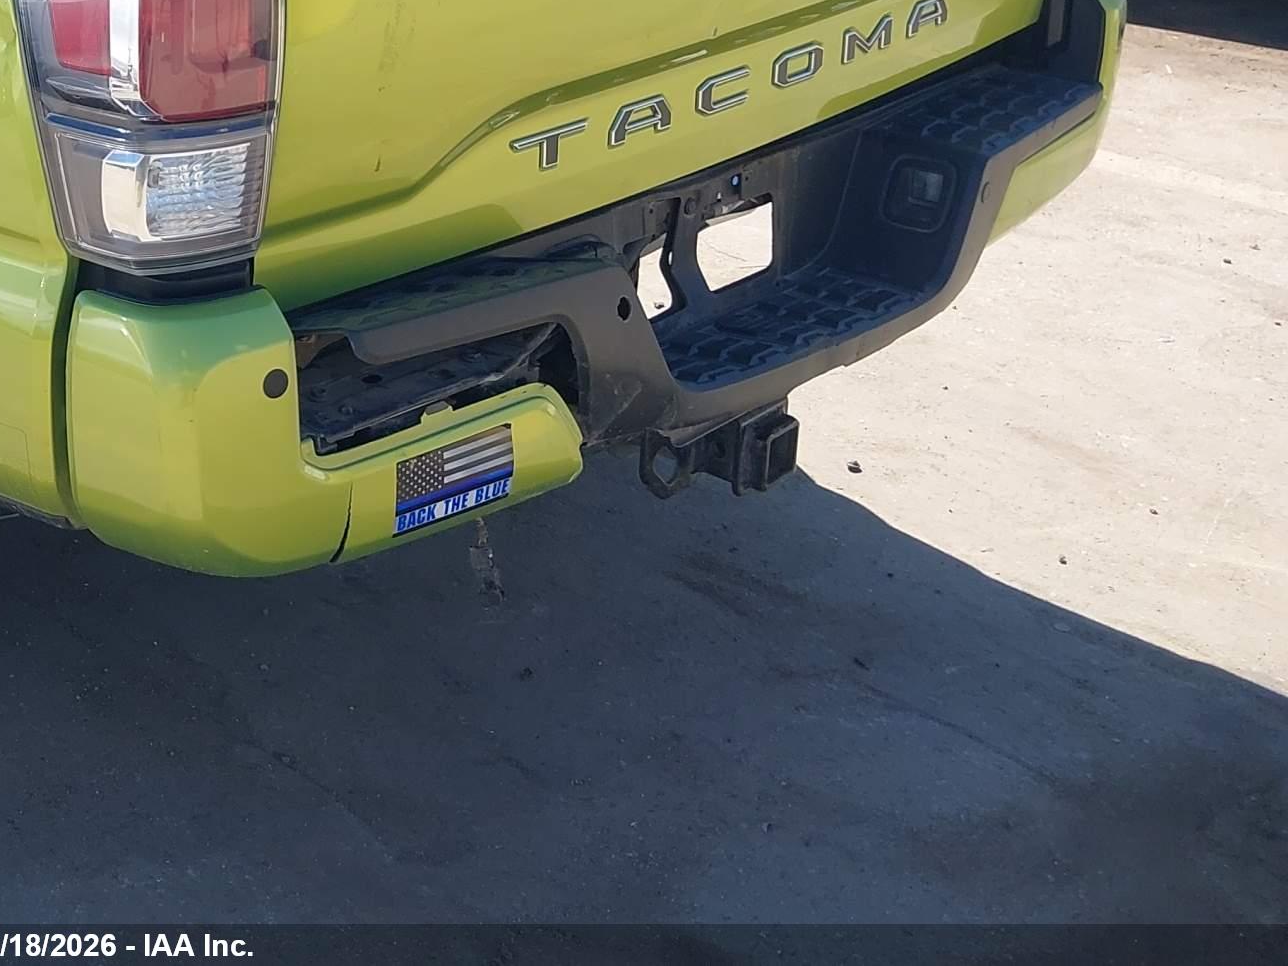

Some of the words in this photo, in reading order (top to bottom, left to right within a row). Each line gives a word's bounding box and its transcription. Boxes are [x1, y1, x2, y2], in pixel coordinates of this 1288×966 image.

[396, 504, 437, 532] BACK
[443, 493, 470, 514] THE
[474, 478, 510, 503] BLUE
